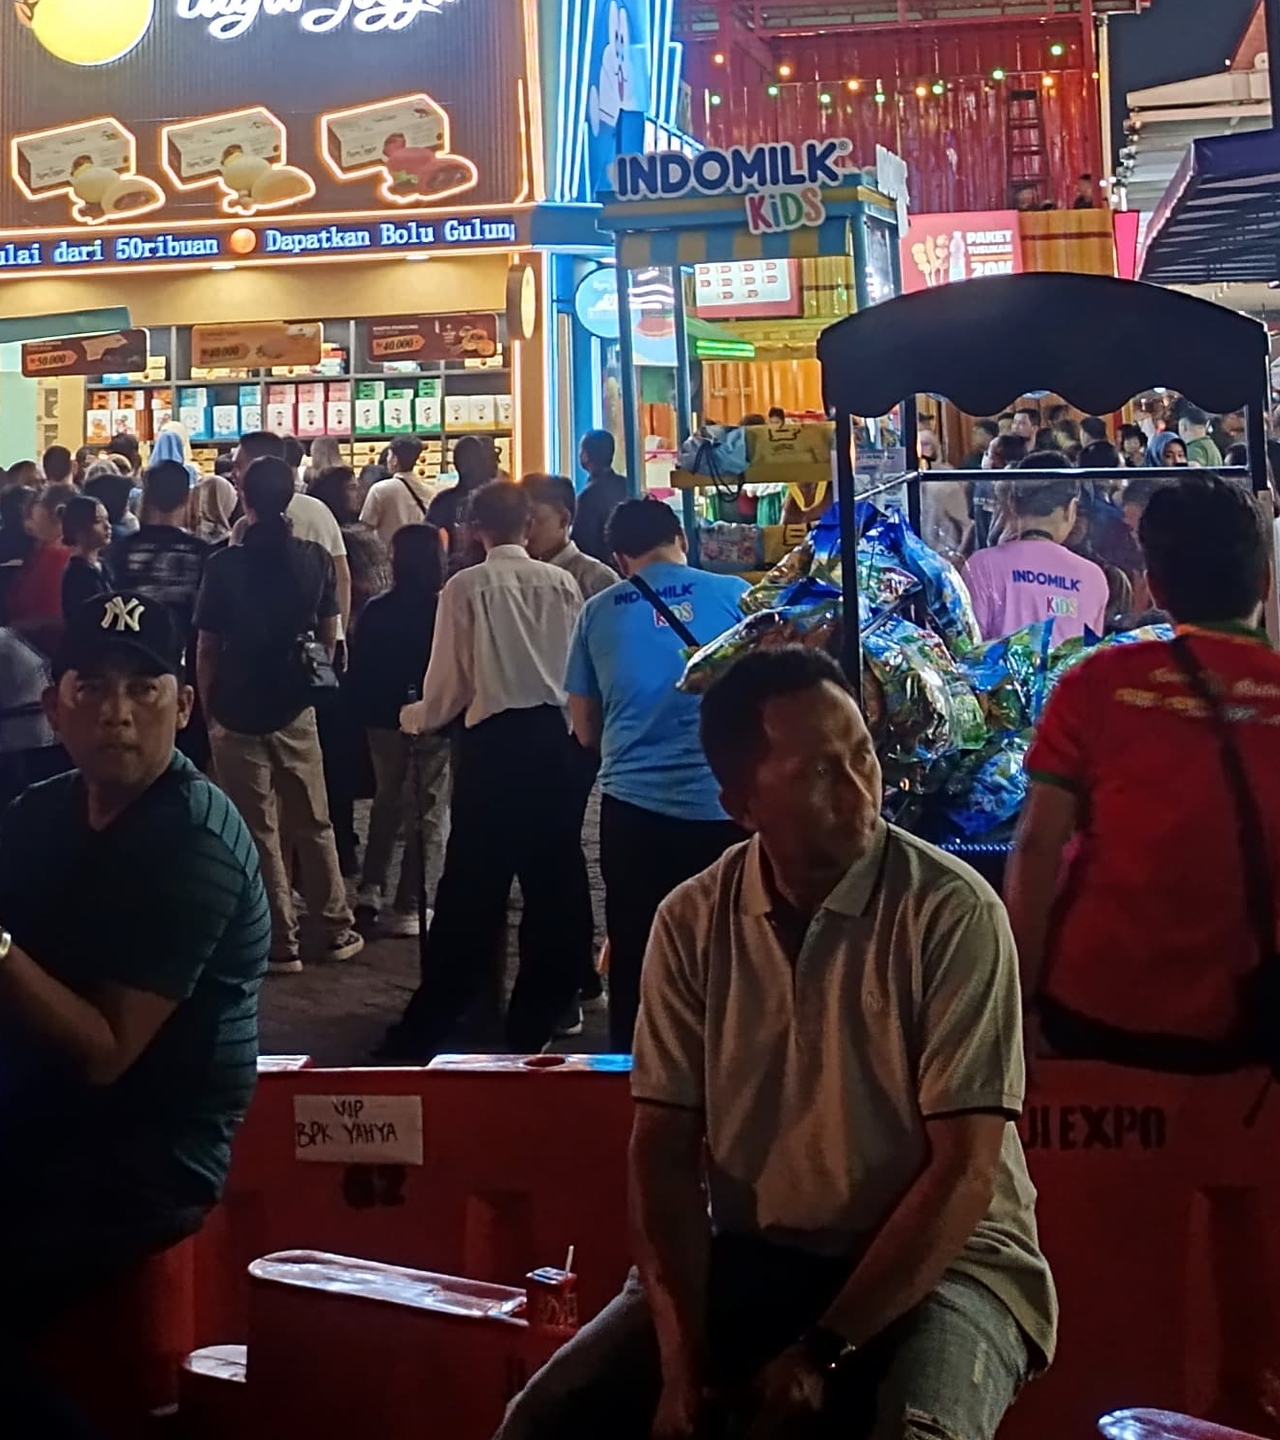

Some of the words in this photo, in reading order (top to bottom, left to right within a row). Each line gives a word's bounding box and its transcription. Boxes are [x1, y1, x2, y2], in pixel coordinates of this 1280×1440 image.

[618, 141, 840, 197] INDOMILK
[54, 239, 104, 262] dari
[116, 234, 219, 260] 50ribuan
[266, 227, 370, 253] Dapatkan
[380, 221, 434, 245] Bolu
[444, 218, 516, 243] Gulun
[966, 230, 1013, 245] PAKET
[614, 583, 695, 606] INDMILK
[1012, 570, 1081, 592] INDOMILK
[101, 596, 145, 631] NY
[332, 1098, 365, 1120] VIP
[296, 1122, 332, 1148] BPK
[344, 1121, 399, 1143] YAHYA
[1059, 1104, 1167, 1151] EXPO
